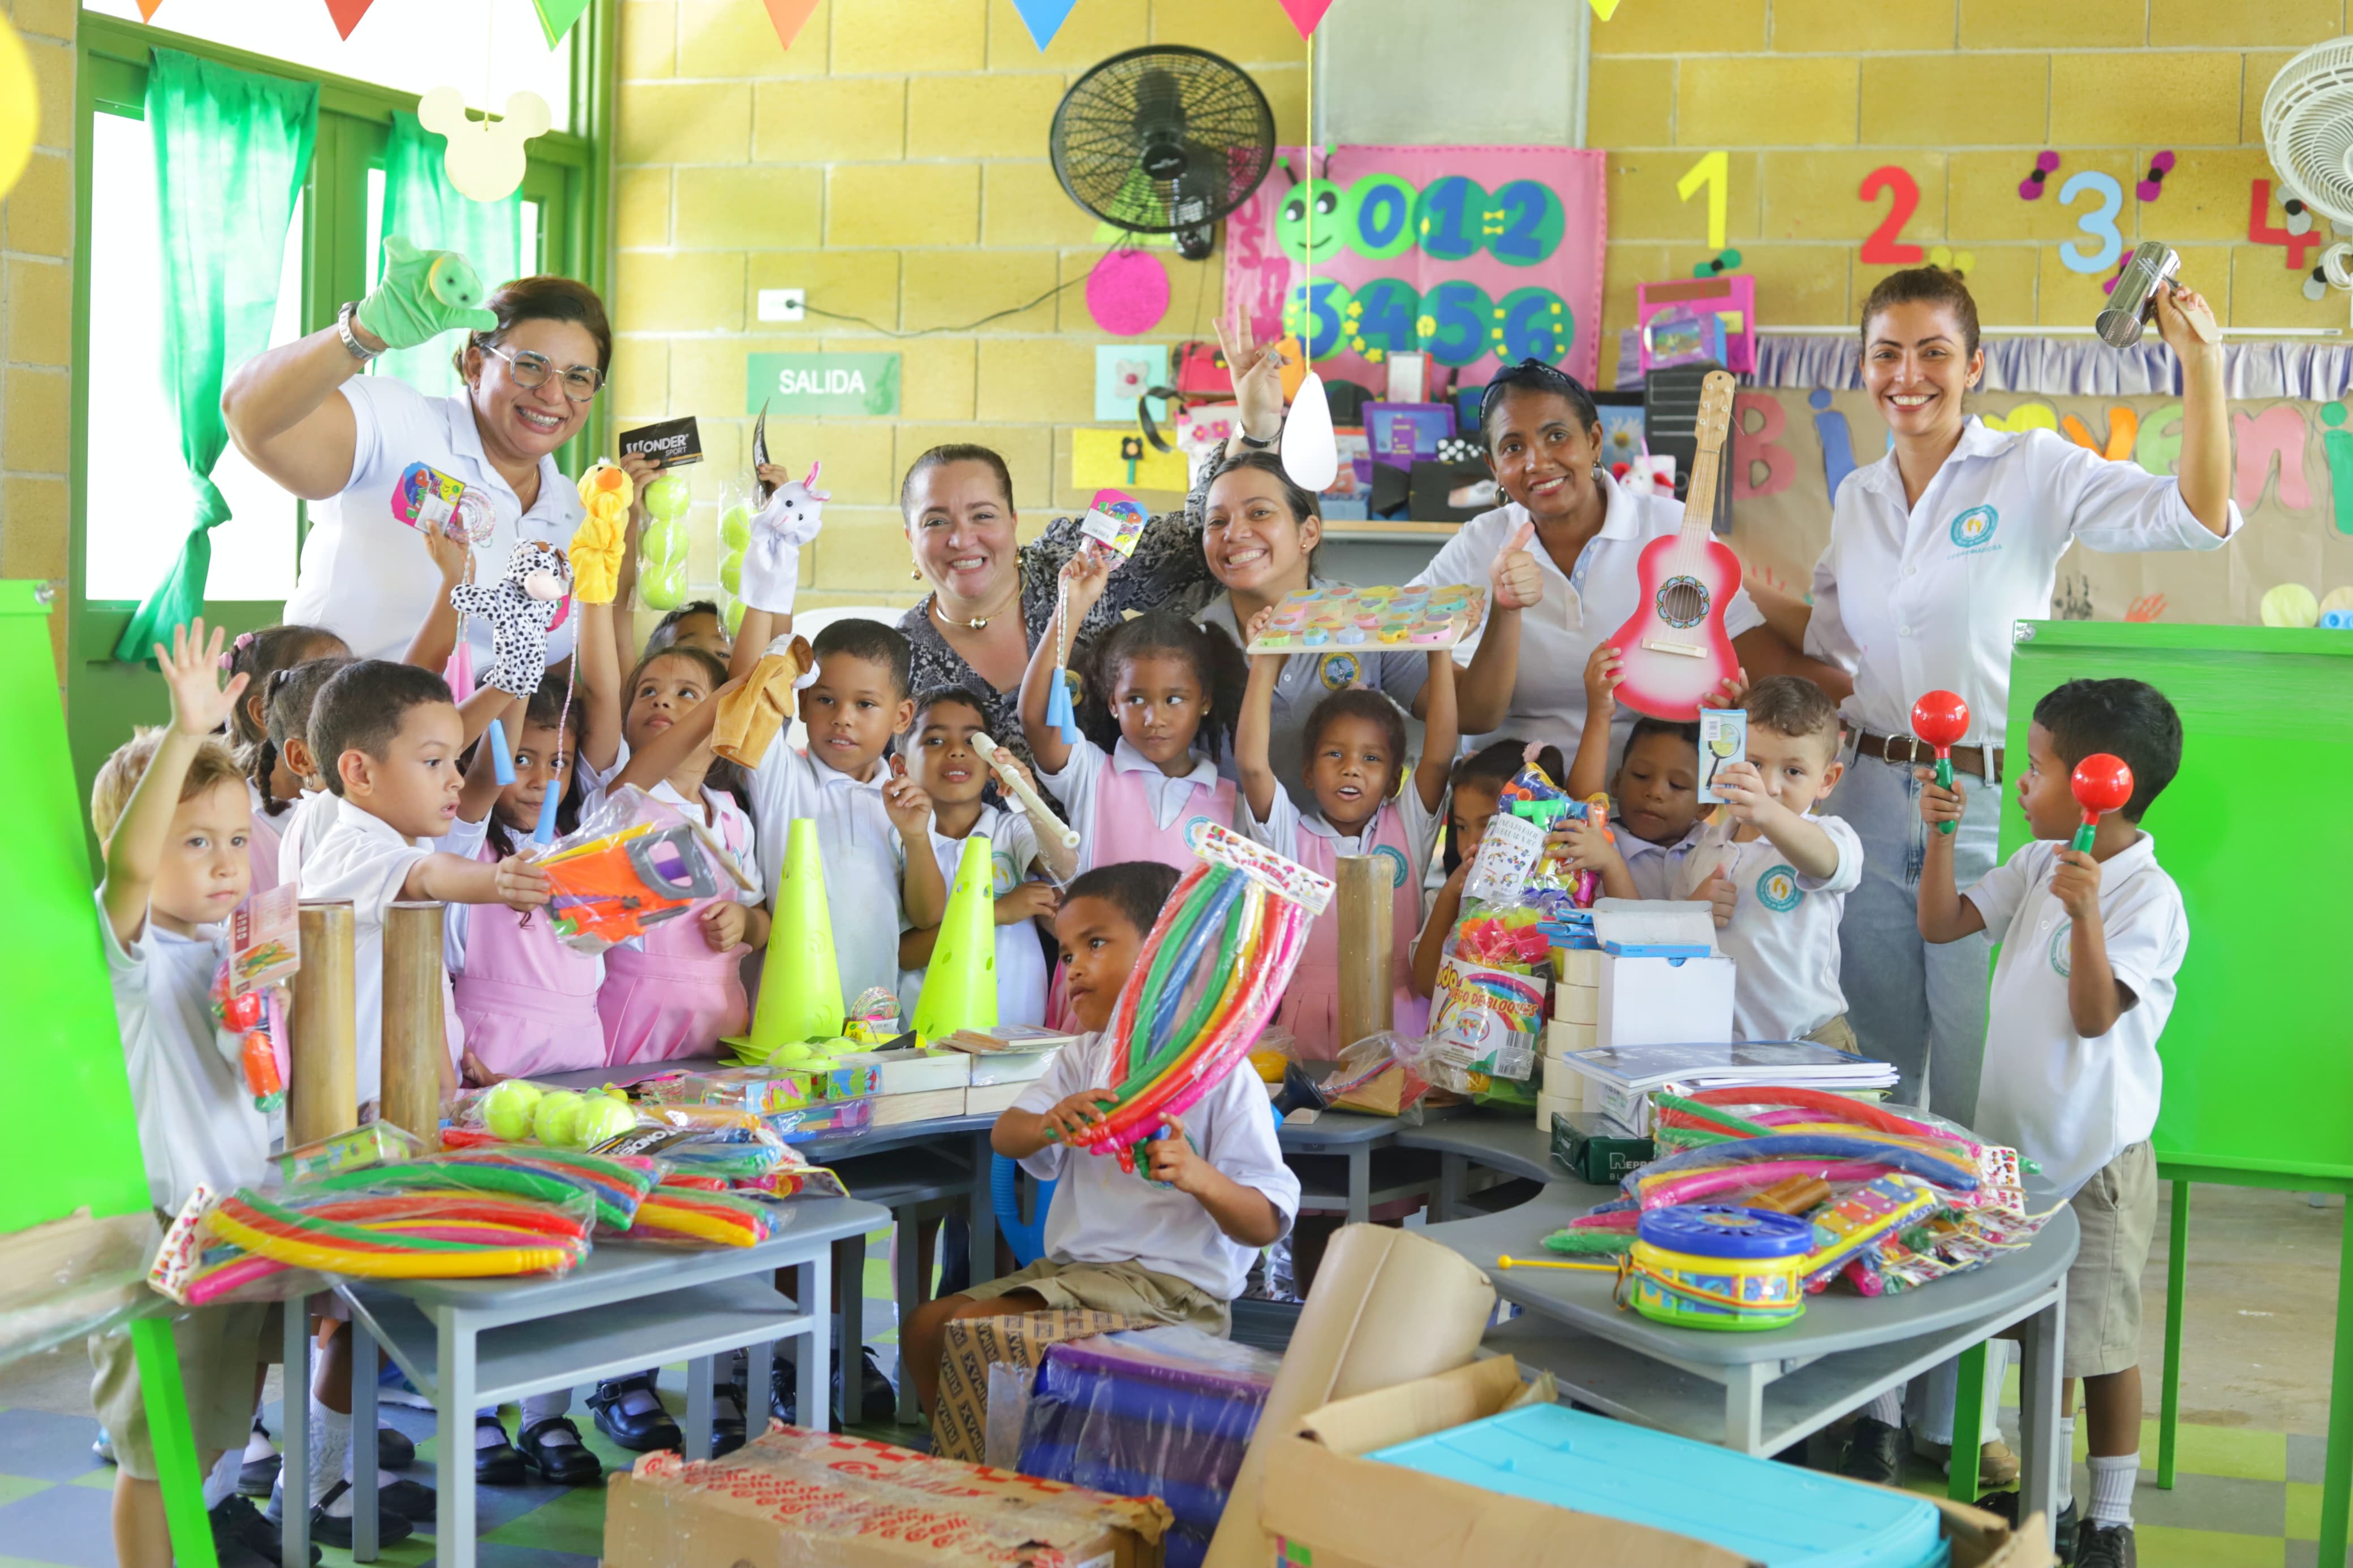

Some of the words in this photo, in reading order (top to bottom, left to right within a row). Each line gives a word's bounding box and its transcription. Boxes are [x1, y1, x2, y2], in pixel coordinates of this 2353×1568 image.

[1359, 183, 1407, 248] 0
[1429, 176, 1472, 257] 1
[1495, 179, 1547, 258] 2
[1677, 151, 1729, 249] 1
[1859, 166, 1924, 264] 2
[2059, 171, 2123, 274] 3
[2249, 179, 2321, 269] 4
[1296, 282, 1341, 359] 3
[1357, 286, 1412, 352] 4
[1428, 286, 1483, 362] 5
[1504, 295, 1556, 365] 6
[779, 369, 866, 394] SALIDA
[666, 446, 687, 456] SPORT
[1449, 987, 1470, 1004] JUEGO
[1471, 994, 1484, 1007] DE
[1486, 998, 1539, 1017] BLOQUES
